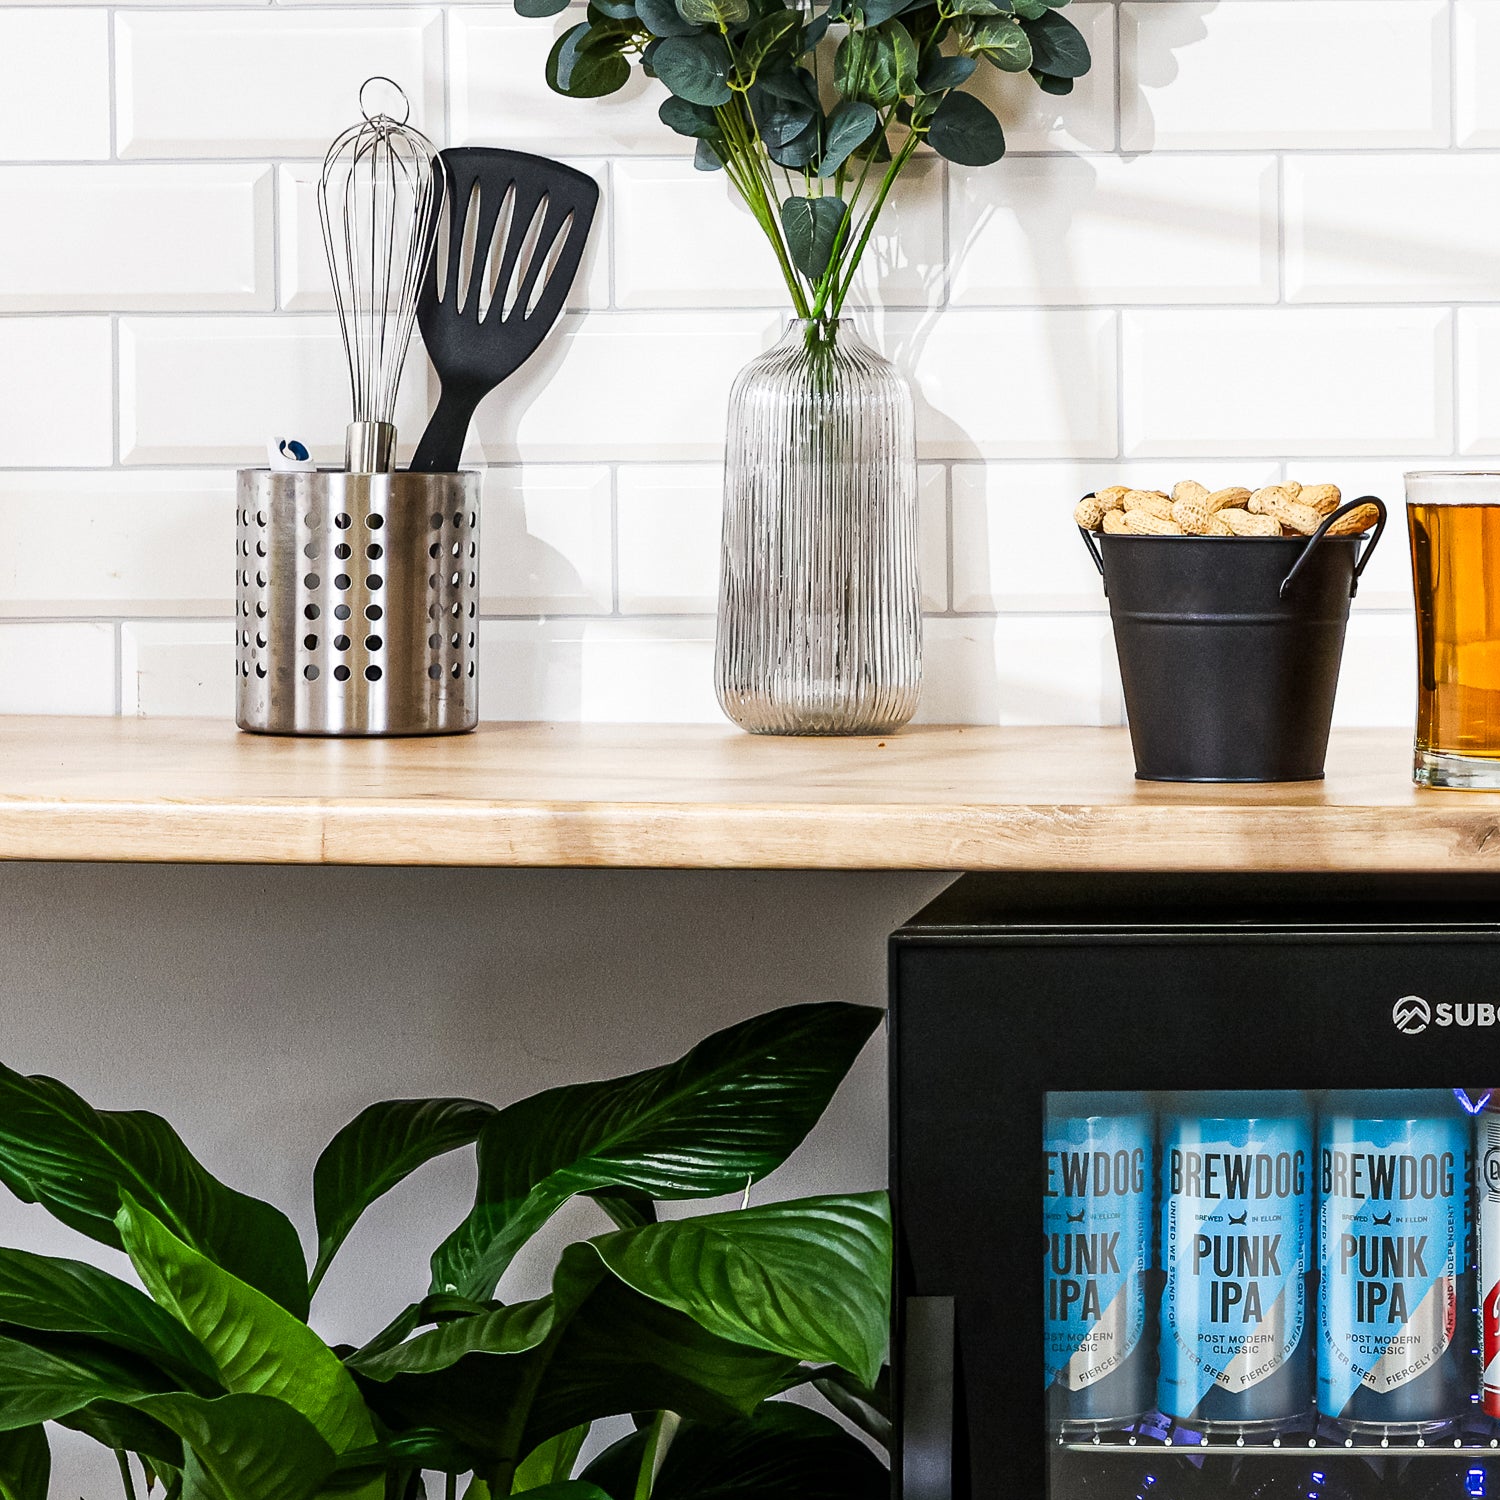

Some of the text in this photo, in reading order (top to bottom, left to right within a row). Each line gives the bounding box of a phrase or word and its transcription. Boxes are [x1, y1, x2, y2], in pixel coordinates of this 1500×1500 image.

[1170, 1149, 1305, 1200] BREWDOG
[1322, 1148, 1454, 1200] BREWDOG
[1195, 1214, 1224, 1222] BREWED
[1193, 1233, 1282, 1278] PUNK
[1341, 1233, 1428, 1278] PUNK
[1050, 1279, 1102, 1321] IPA
[1170, 1244, 1176, 1261] WE
[1173, 1331, 1201, 1366] BETTER
[1203, 1364, 1231, 1384] BEER
[1210, 1281, 1263, 1323] IPA
[1356, 1281, 1408, 1324] IPA
[1386, 1354, 1431, 1385] FIERCELY
[1432, 1313, 1453, 1354] DEFIANT
[1447, 1205, 1455, 1281] INDEPENDENT
[1052, 1343, 1098, 1352] CLASSIC
[1067, 1332, 1113, 1341] MODERN
[1198, 1334, 1275, 1344] POST MODERN
[1213, 1346, 1259, 1354] CLASSIC
[1324, 1330, 1377, 1384] BETTER BEER
[1345, 1333, 1421, 1344] POST MODERN
[1359, 1346, 1405, 1355] CLASSIC
[1078, 1349, 1123, 1383] FIERCELY
[1240, 1352, 1284, 1385] FIERCELY
